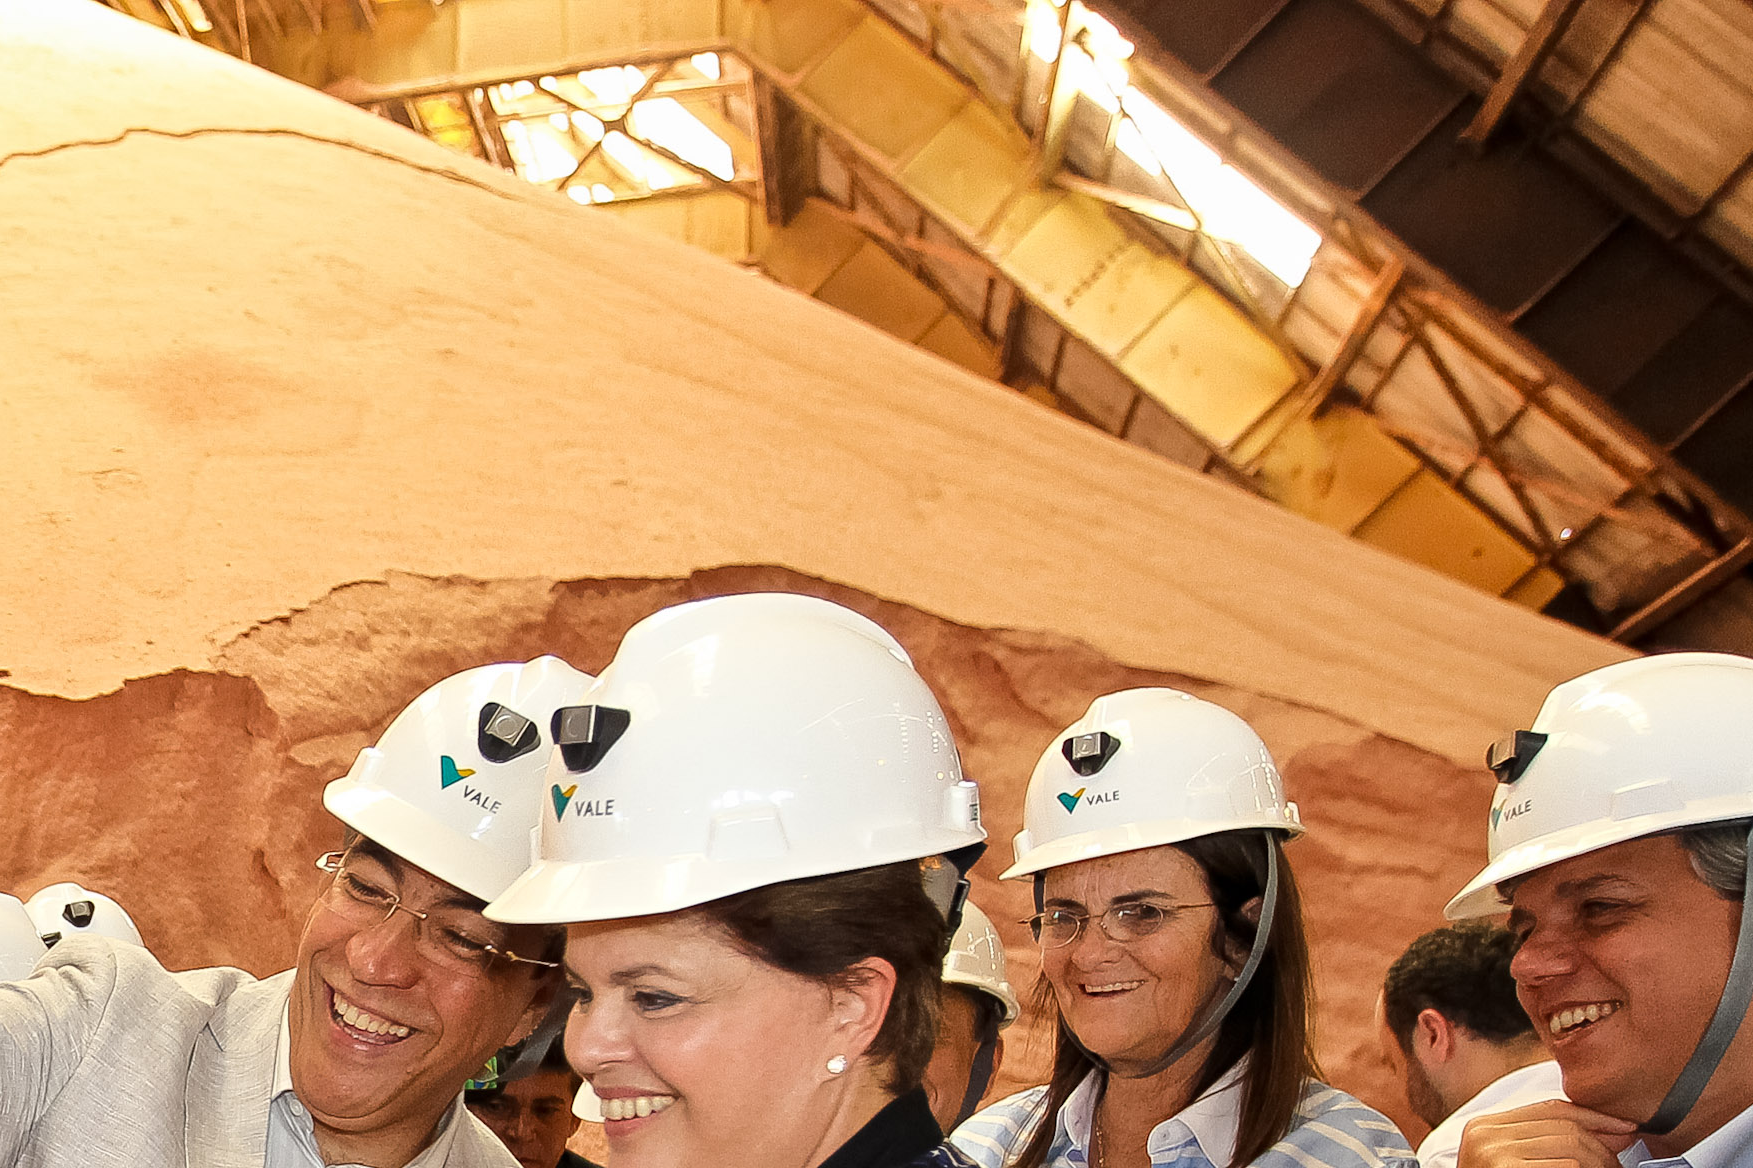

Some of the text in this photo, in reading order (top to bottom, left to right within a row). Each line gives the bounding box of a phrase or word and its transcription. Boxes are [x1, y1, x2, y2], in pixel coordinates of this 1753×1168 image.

[463, 784, 503, 815] VALE
[574, 799, 615, 817] VALE
[1086, 790, 1120, 806] VALE
[1503, 799, 1533, 822] VALE
